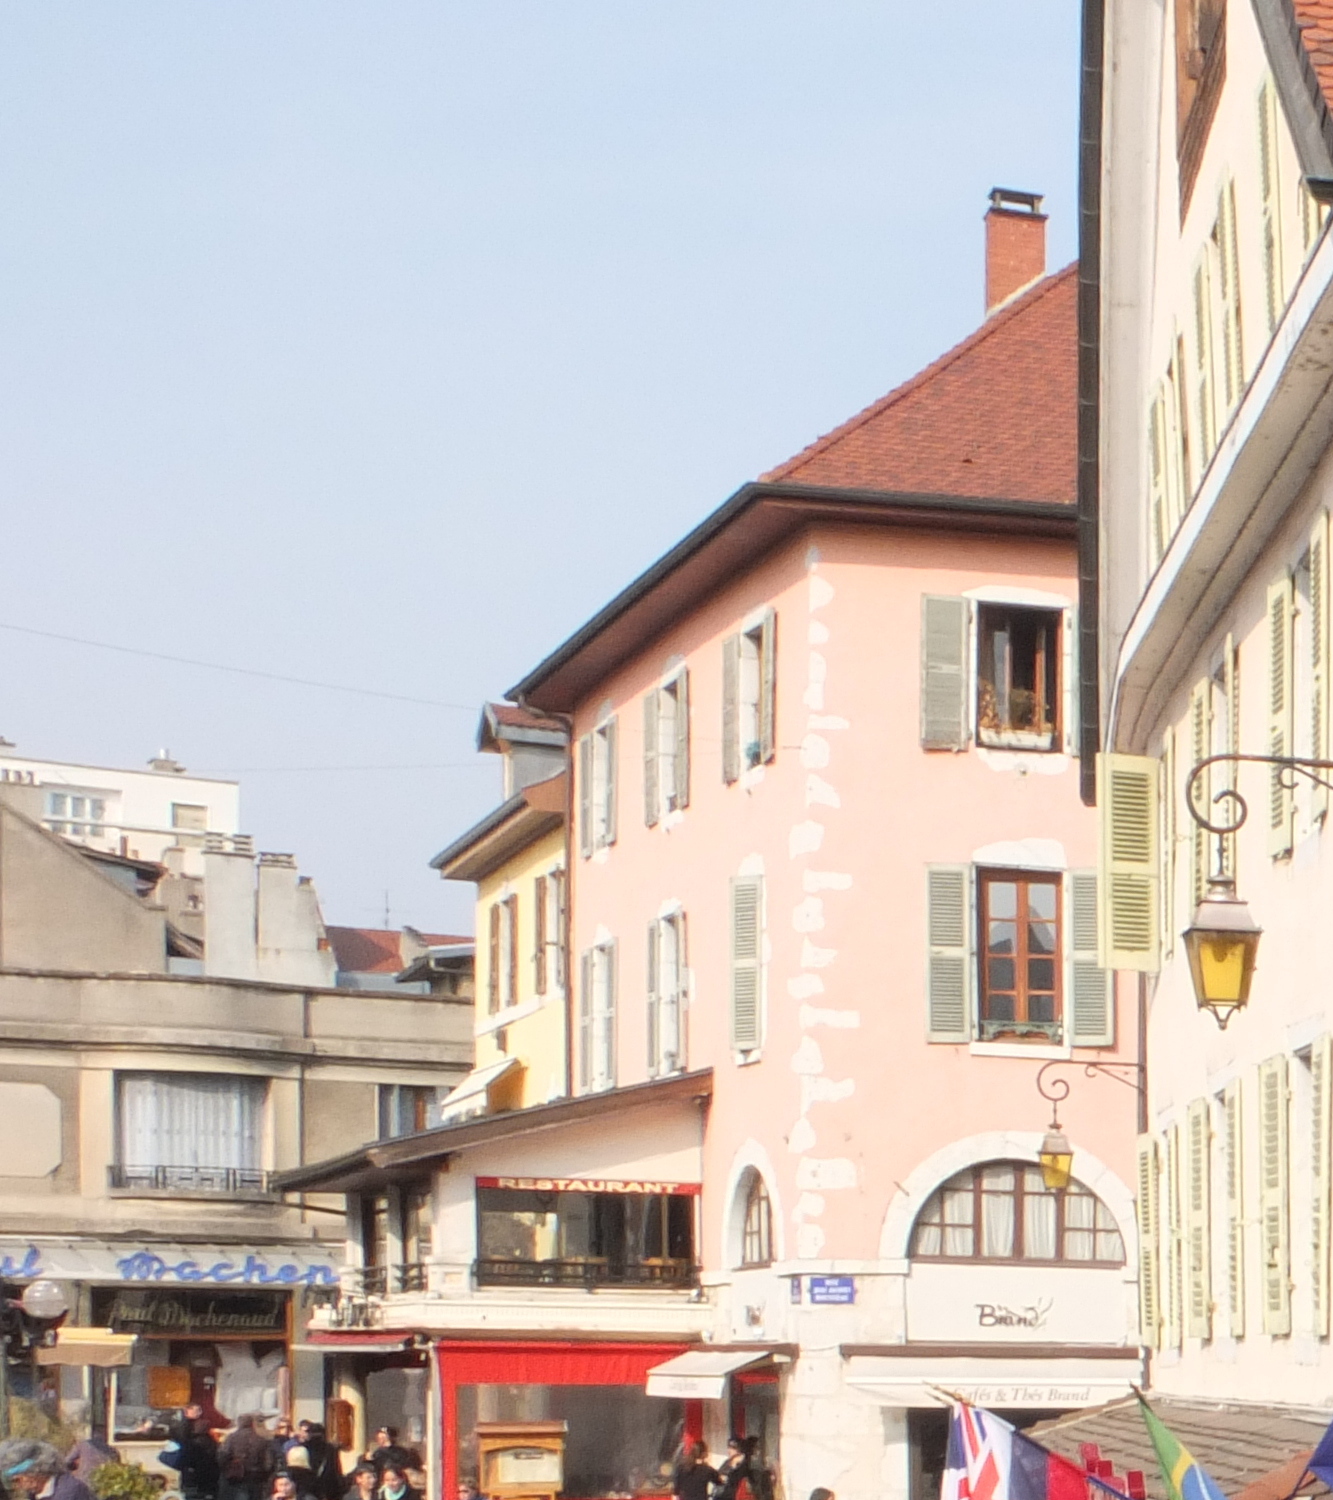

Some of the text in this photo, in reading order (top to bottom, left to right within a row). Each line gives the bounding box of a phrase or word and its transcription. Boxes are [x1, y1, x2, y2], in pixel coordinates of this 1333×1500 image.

[498, 1178, 679, 1193] RESTAURANT
[974, 1303, 1041, 1328] Brand
[1047, 1387, 1091, 1402] Brand
